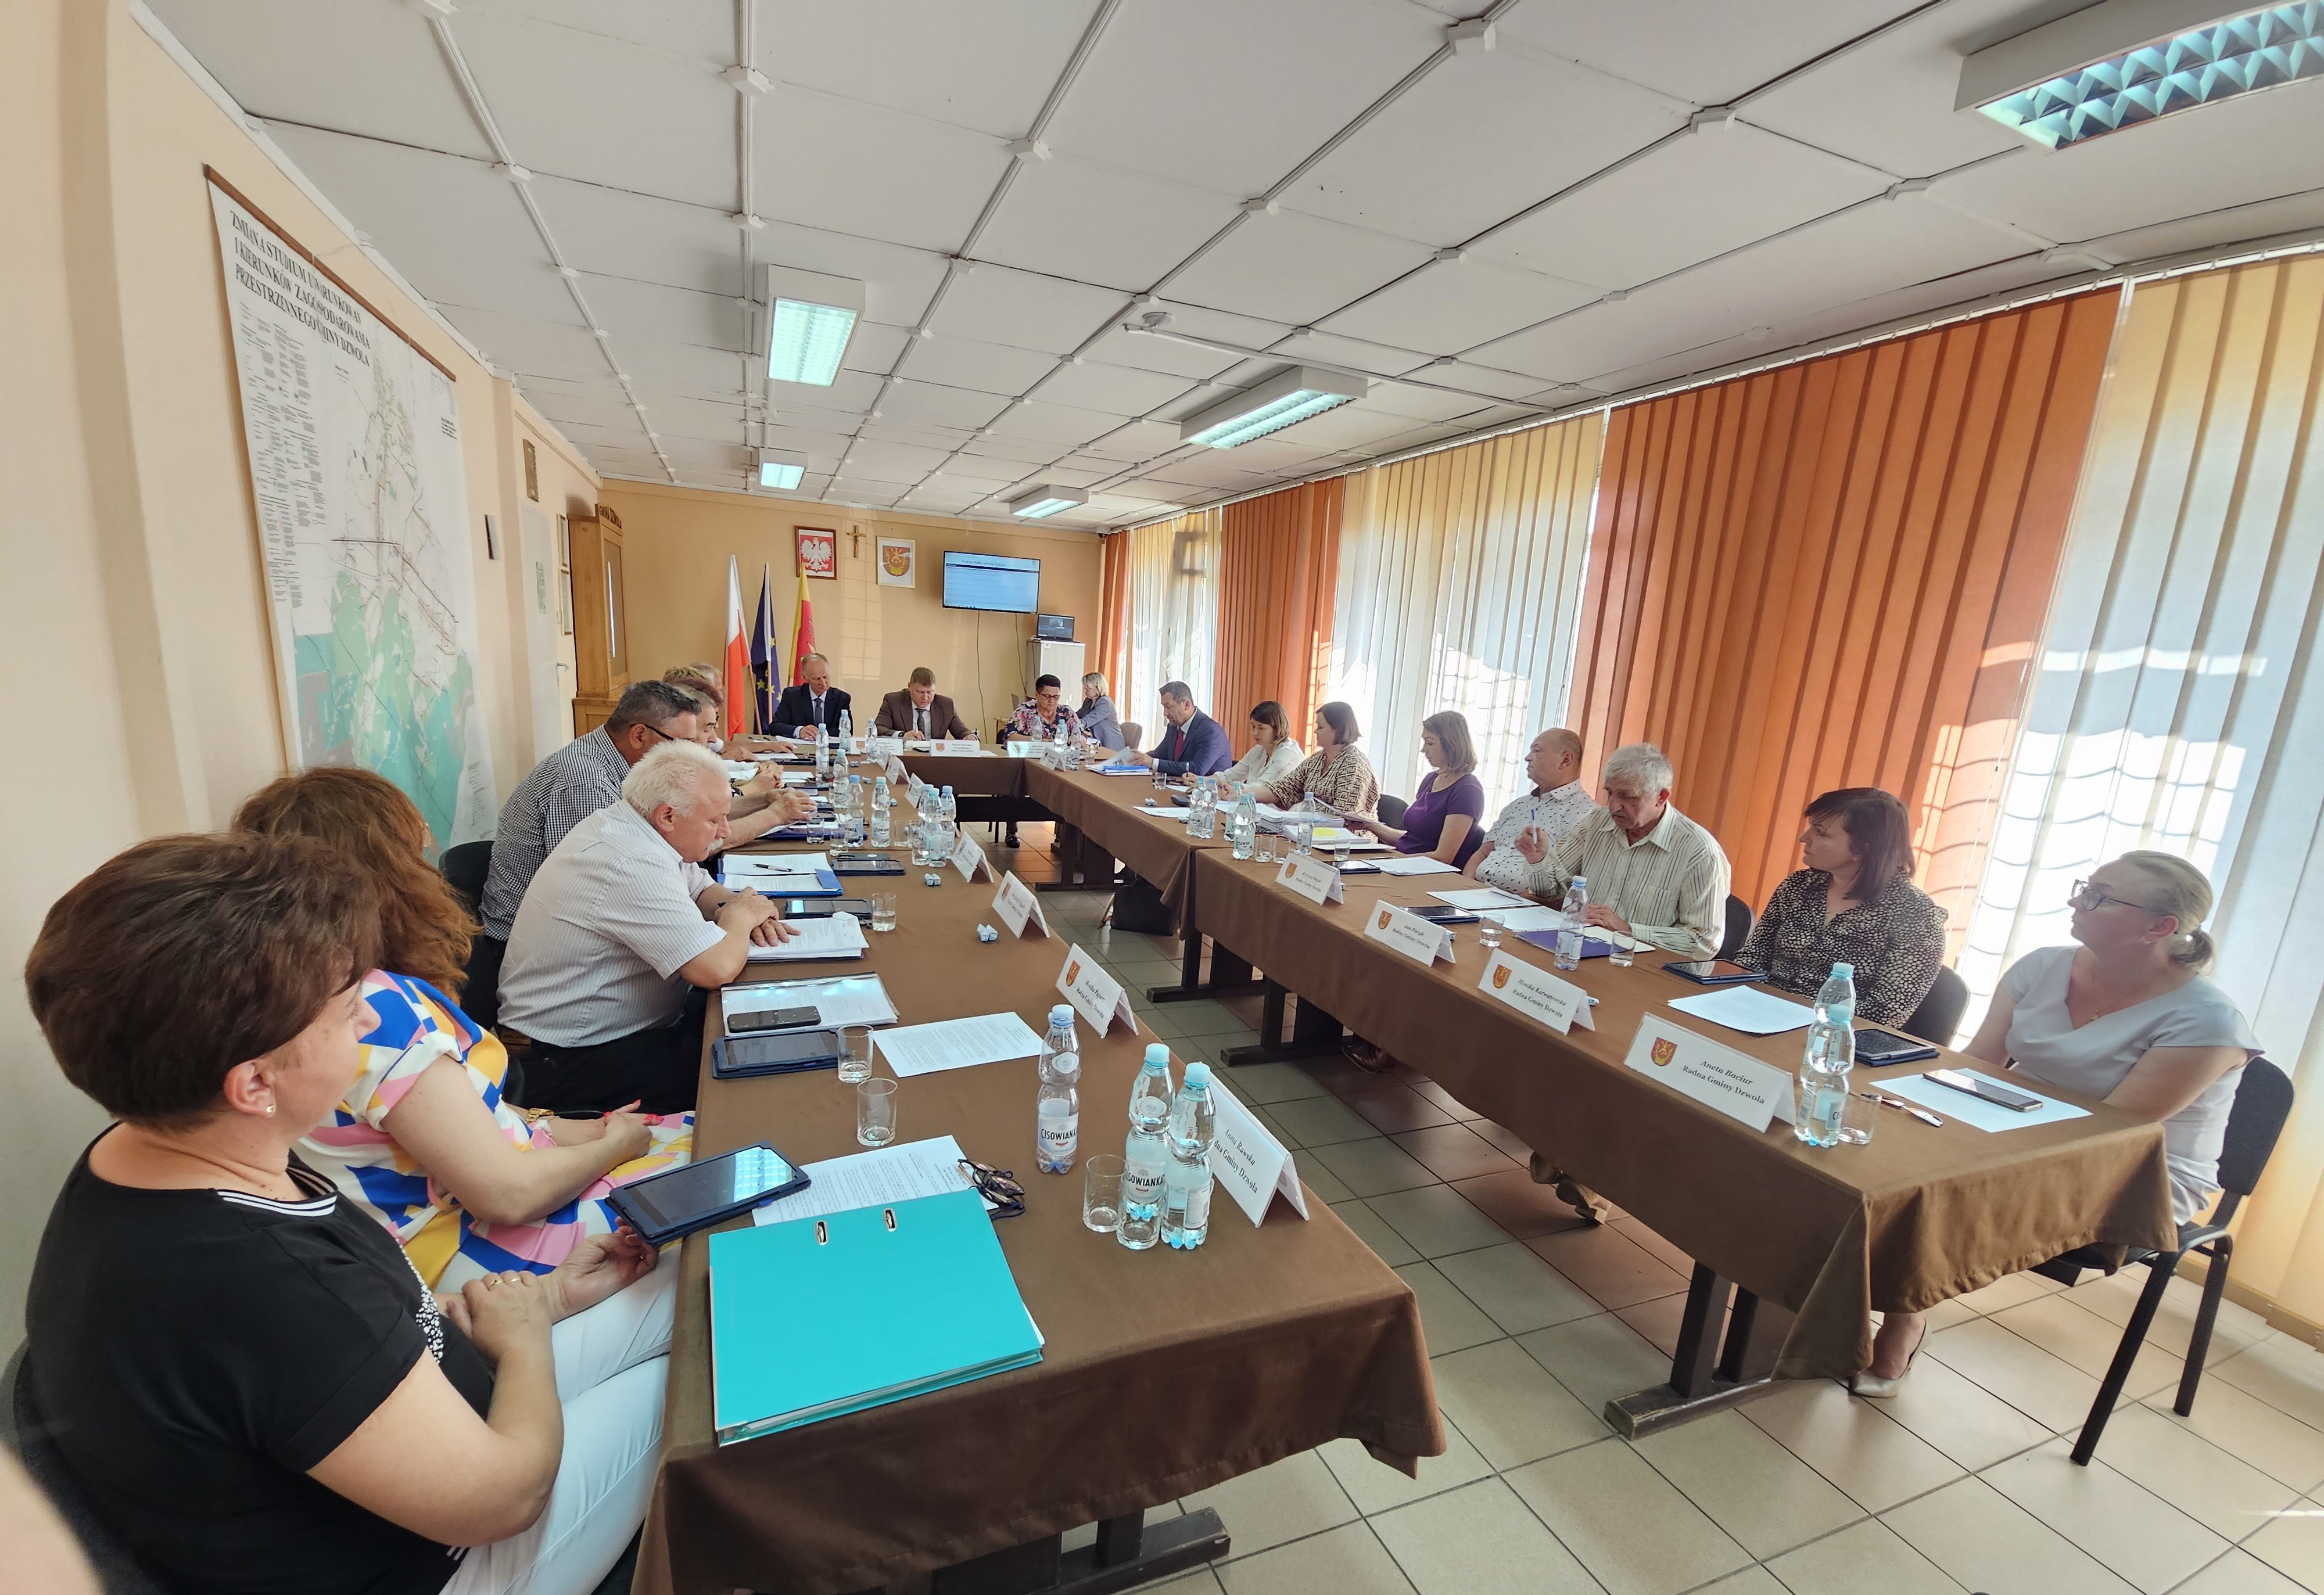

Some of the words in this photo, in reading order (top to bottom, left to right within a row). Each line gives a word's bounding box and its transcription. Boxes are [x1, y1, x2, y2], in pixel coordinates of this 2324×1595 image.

[230, 210, 266, 254] ZMIANA
[266, 240, 307, 283] STUDIUM
[239, 241, 292, 292] KIERUNKÓW
[235, 262, 316, 331] PRZESTRZENNEGO
[340, 336, 370, 367] DZWOLA
[1404, 933, 1416, 944] Gminy
[1416, 939, 1430, 949] Dzwola
[1512, 988, 1527, 1000] Radna
[1528, 996, 1545, 1009] Gminy
[1544, 1004, 1563, 1018] Dzwola
[1518, 979, 1534, 991] Monika
[1534, 987, 1567, 1007] Karwatowska
[1093, 1004, 1104, 1019] Dzwola
[1682, 1065, 1706, 1080] Radna
[1707, 1075, 1733, 1092] Gminy
[1734, 1086, 1765, 1104] Dzwola
[1700, 1060, 1724, 1074] Aneta
[1724, 1069, 1753, 1085] Baciur
[1041, 1127, 1077, 1141] CISOWIANK
[1224, 1129, 1238, 1145] Anna
[1236, 1141, 1256, 1166] Rawska
[1214, 1140, 1224, 1154] dna
[1222, 1149, 1240, 1173] Gminy
[1239, 1167, 1258, 1194] Dzwola
